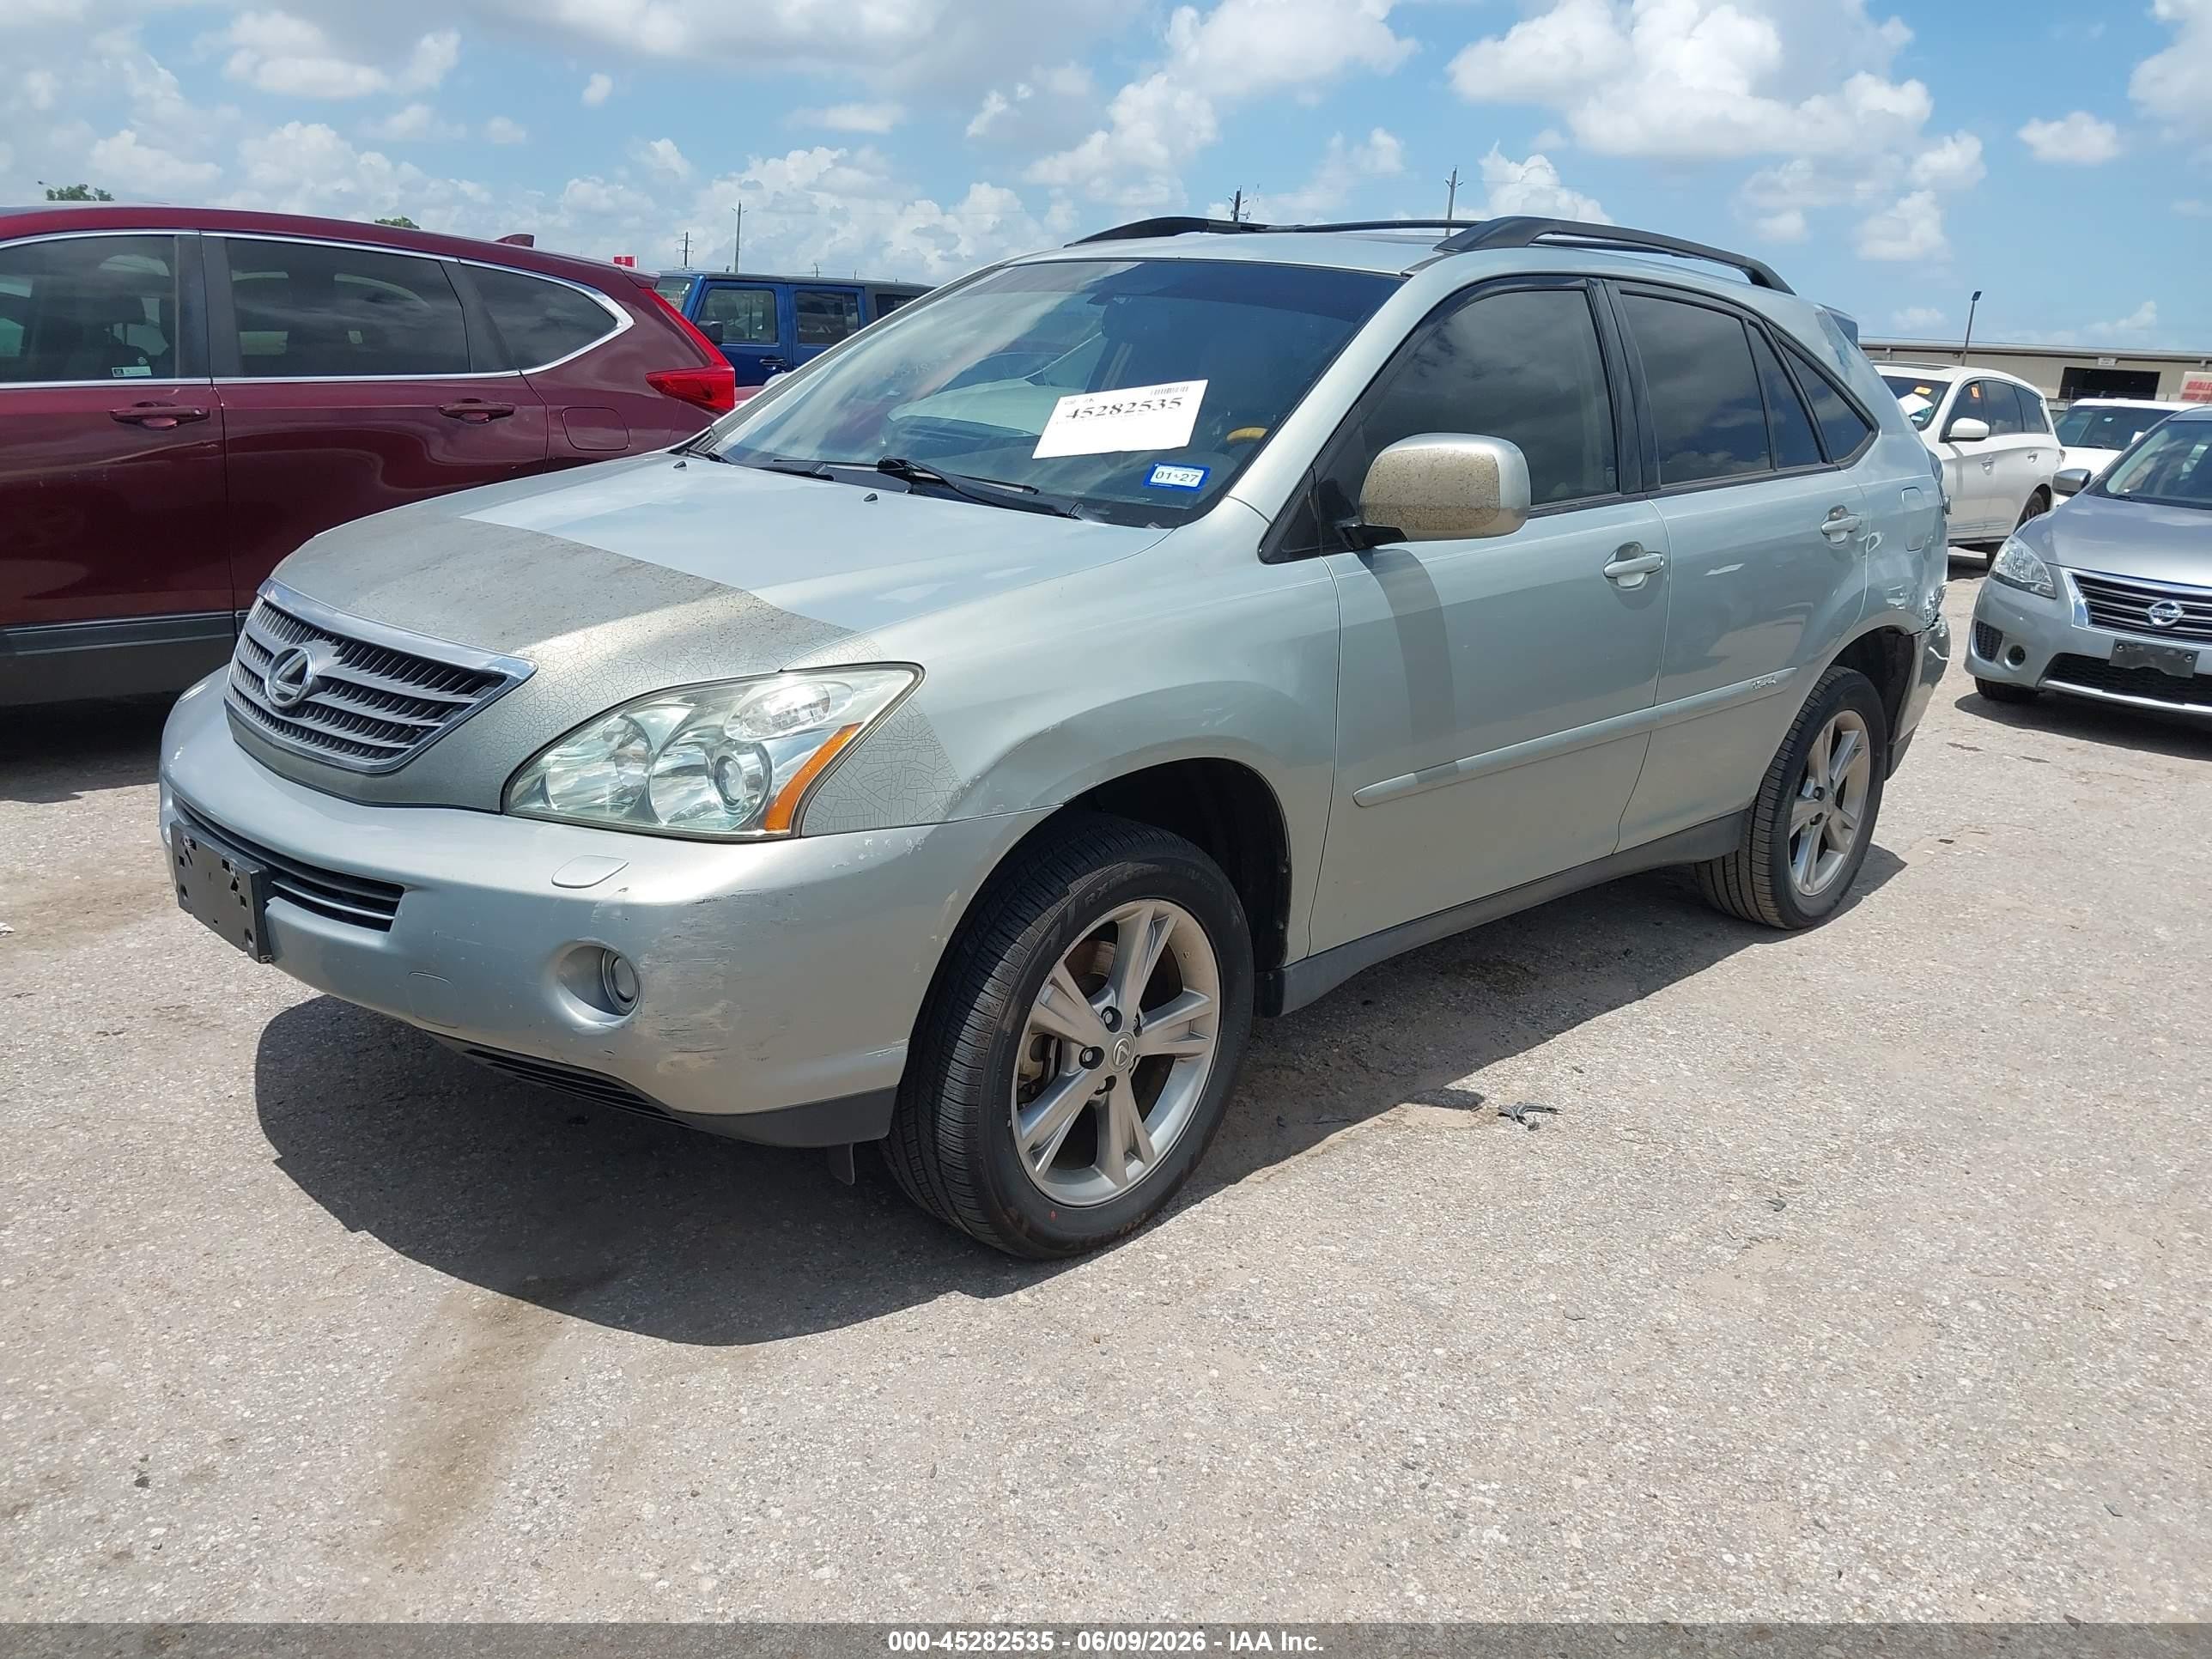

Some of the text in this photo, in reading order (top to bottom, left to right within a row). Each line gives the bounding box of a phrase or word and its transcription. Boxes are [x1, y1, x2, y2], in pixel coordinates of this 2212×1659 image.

[1066, 397, 1182, 419] 45282535
[1155, 471, 1200, 483] 01 27
